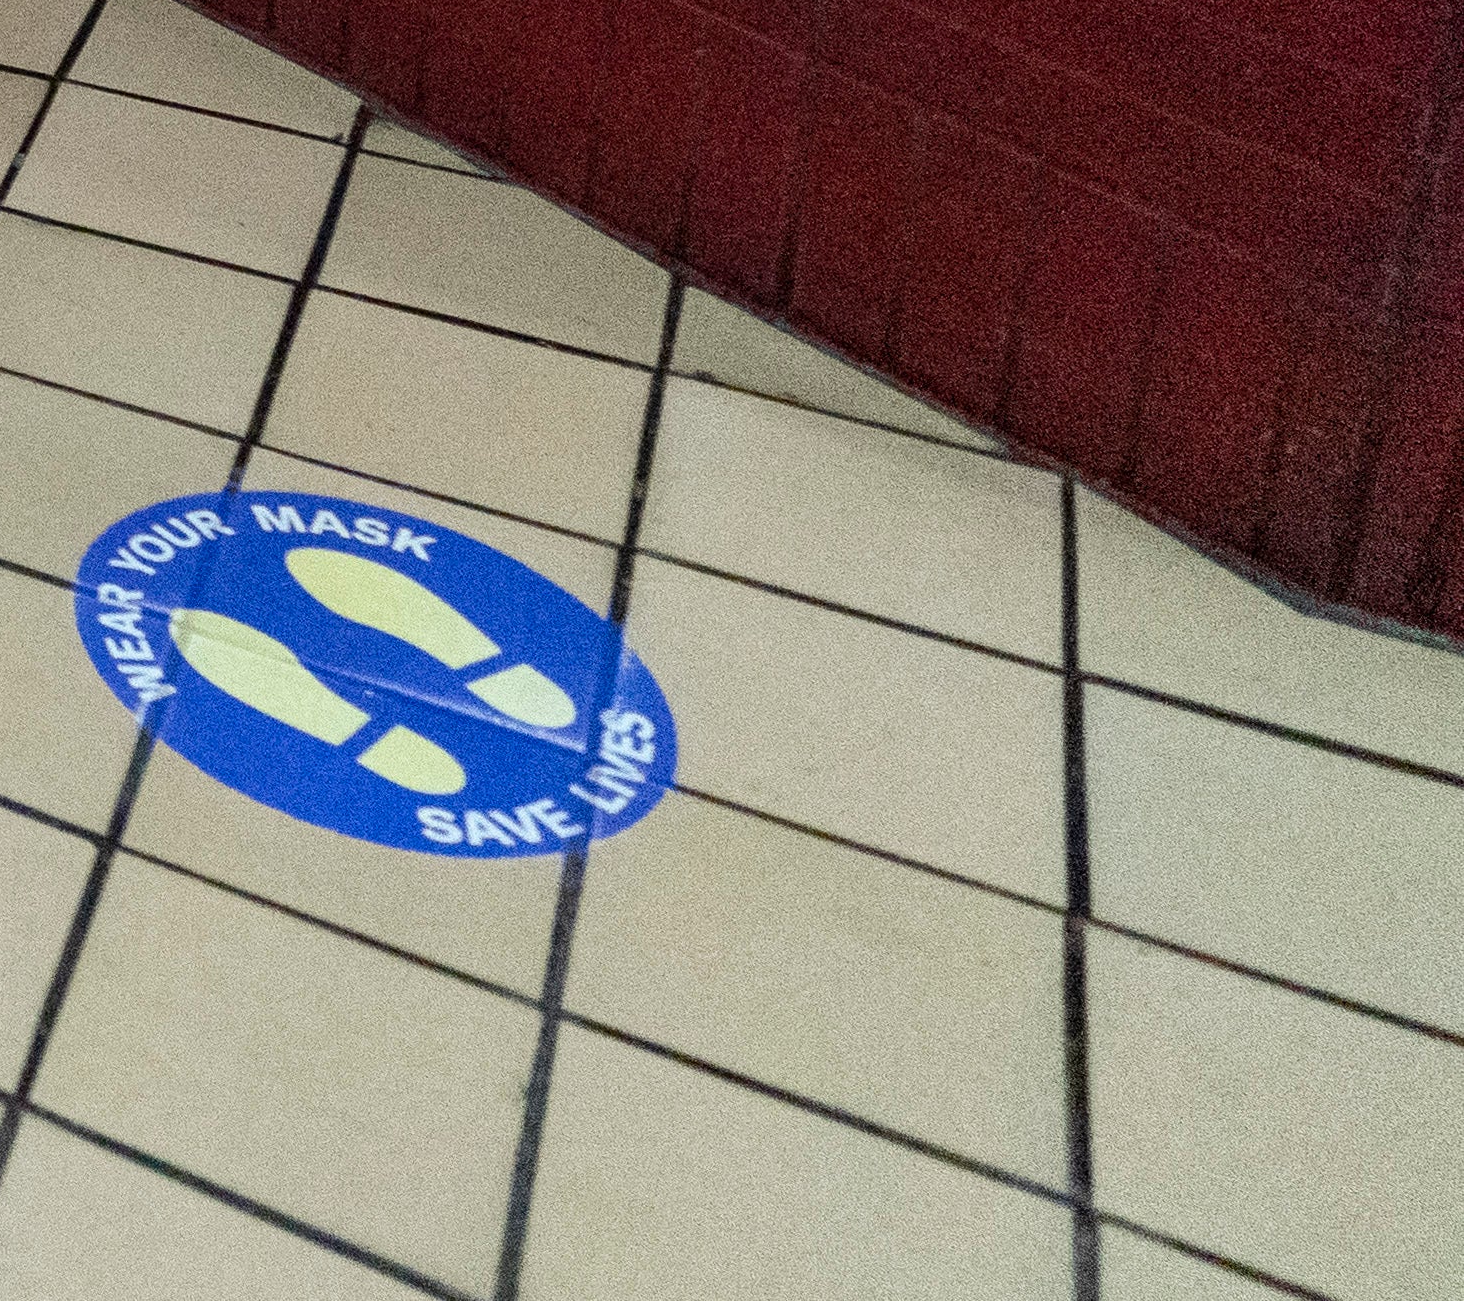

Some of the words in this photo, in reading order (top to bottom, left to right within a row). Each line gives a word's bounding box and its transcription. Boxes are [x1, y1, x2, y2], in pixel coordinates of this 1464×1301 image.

[109, 509, 236, 576] YOUR
[250, 504, 437, 562] MASK
[97, 580, 177, 701] WEAR
[416, 798, 586, 847] SAVE
[569, 707, 657, 815] LIVES
